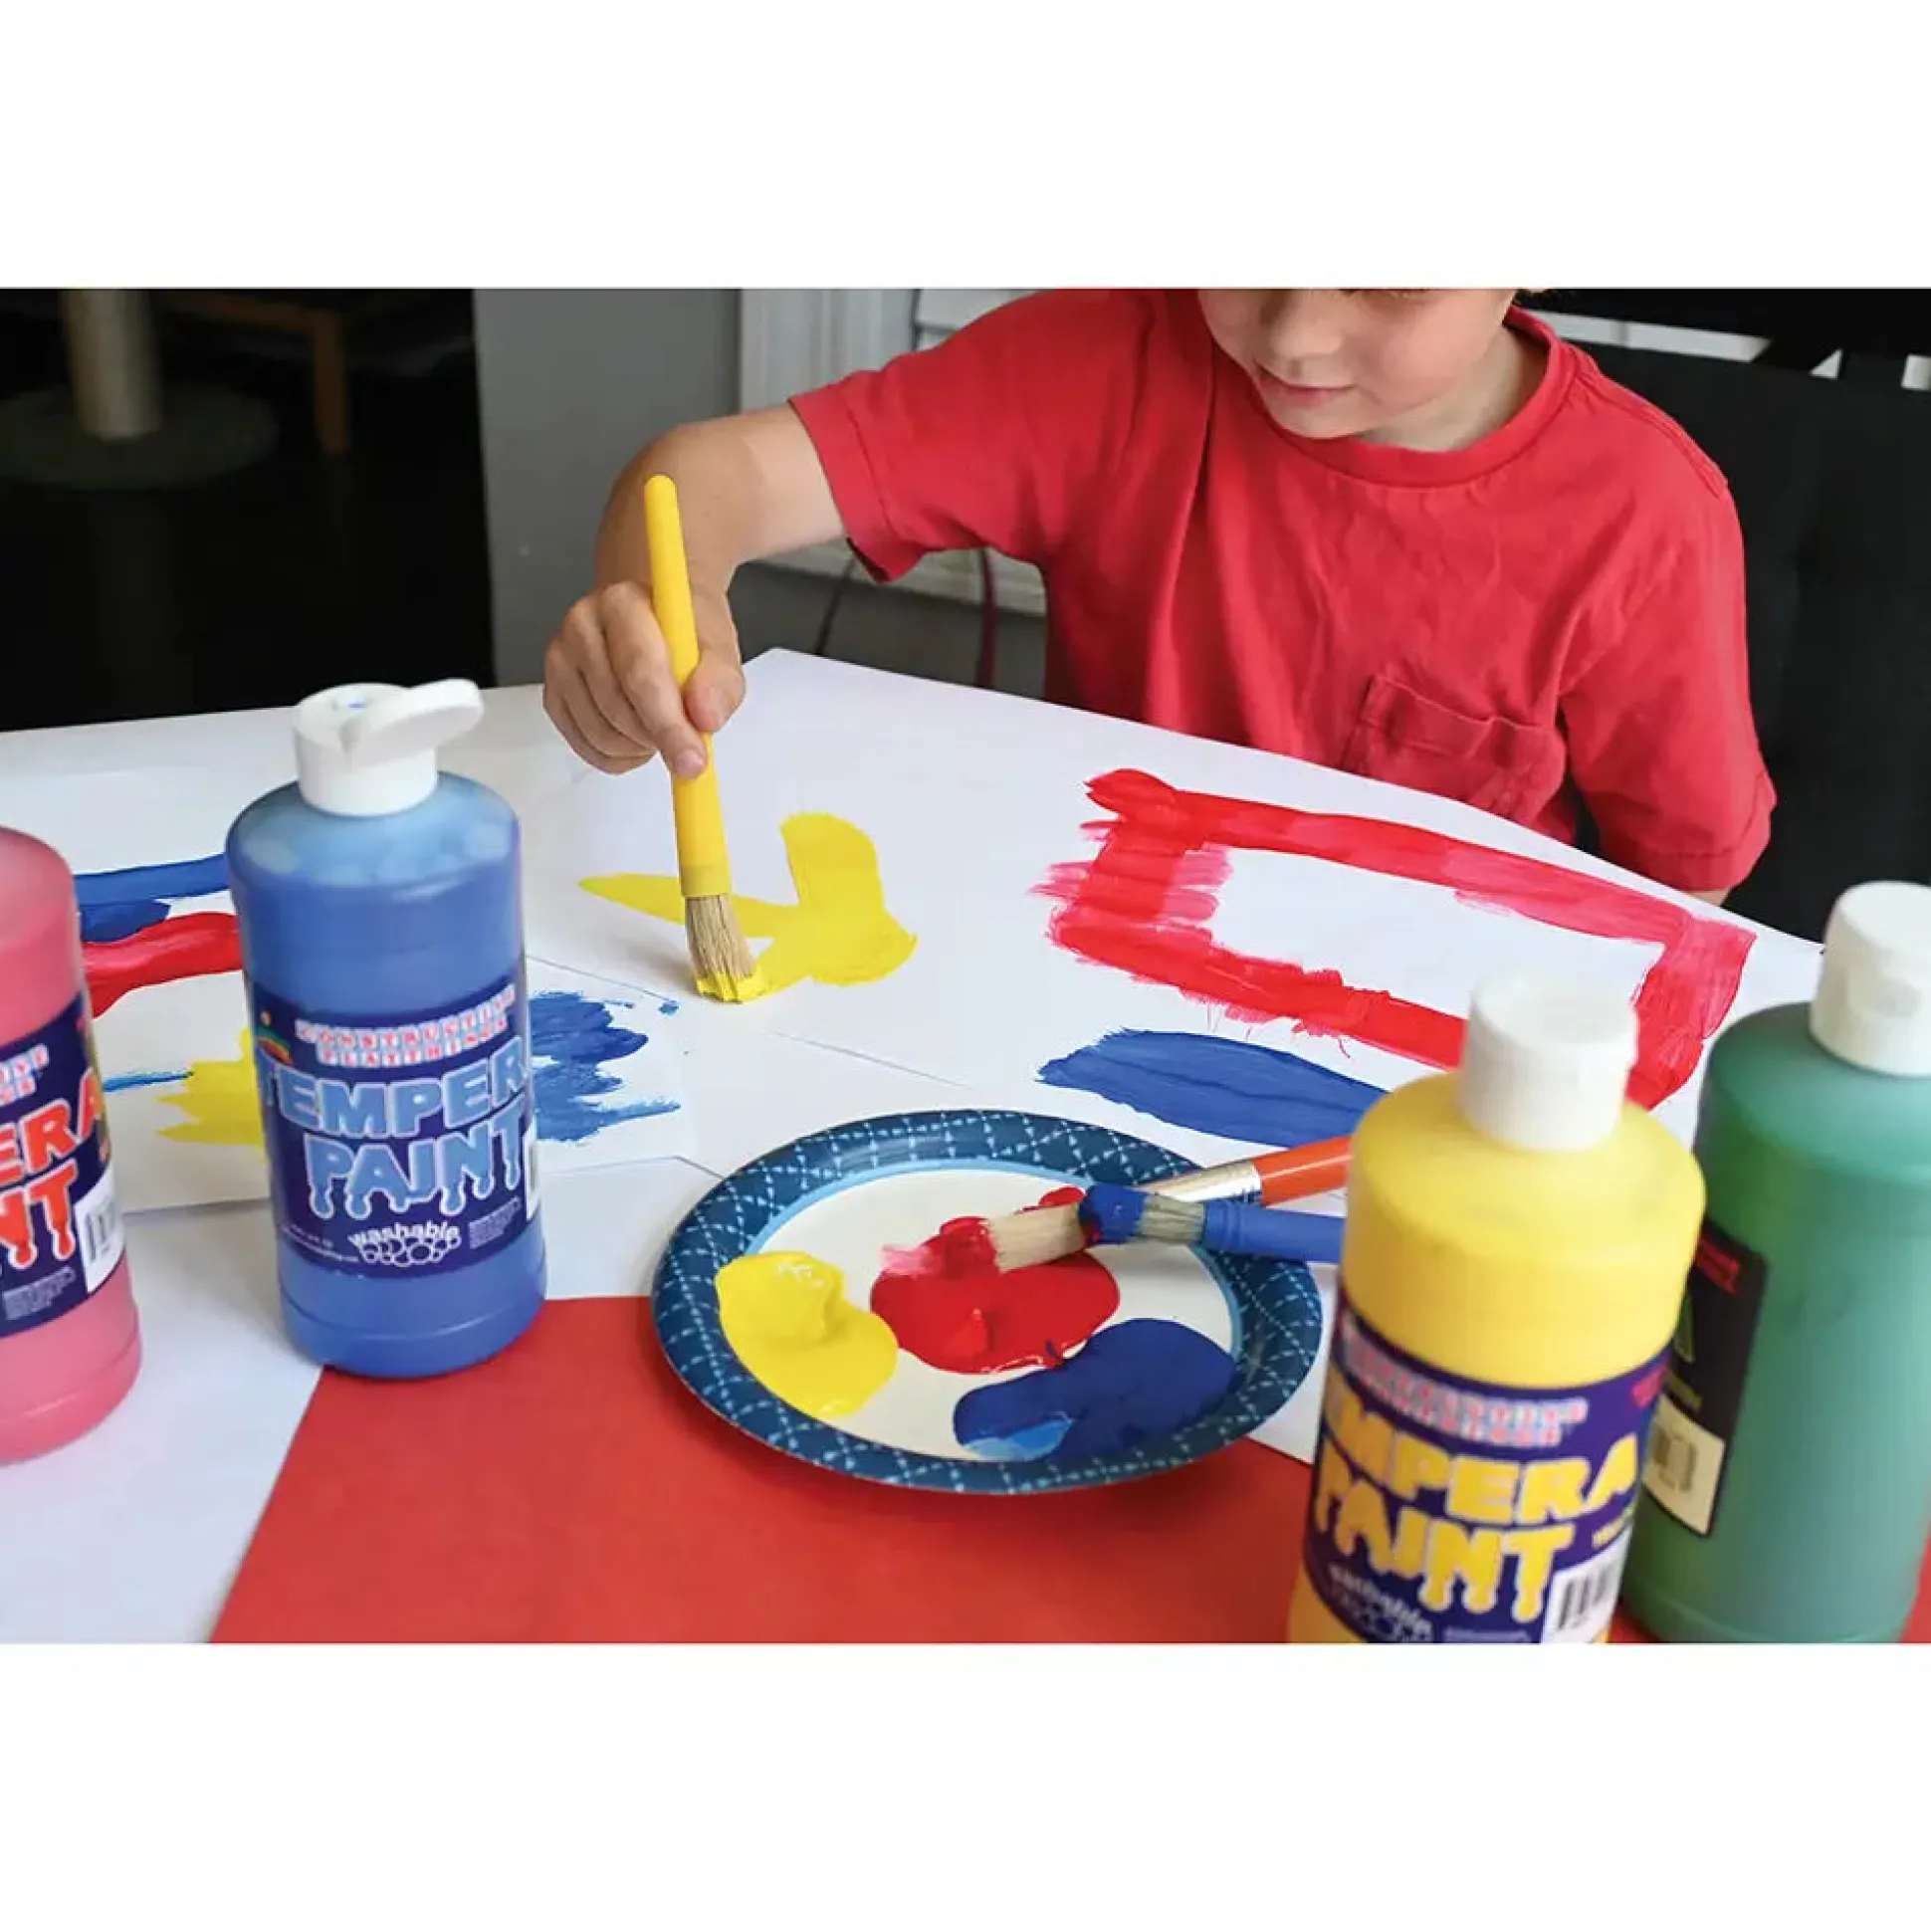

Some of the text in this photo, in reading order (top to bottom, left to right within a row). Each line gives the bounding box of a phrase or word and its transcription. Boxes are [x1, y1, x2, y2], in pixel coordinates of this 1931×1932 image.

[304, 1093, 526, 1220] PAINT
[348, 1221, 460, 1250] washable
[1315, 1438, 1576, 1622] PAINT
